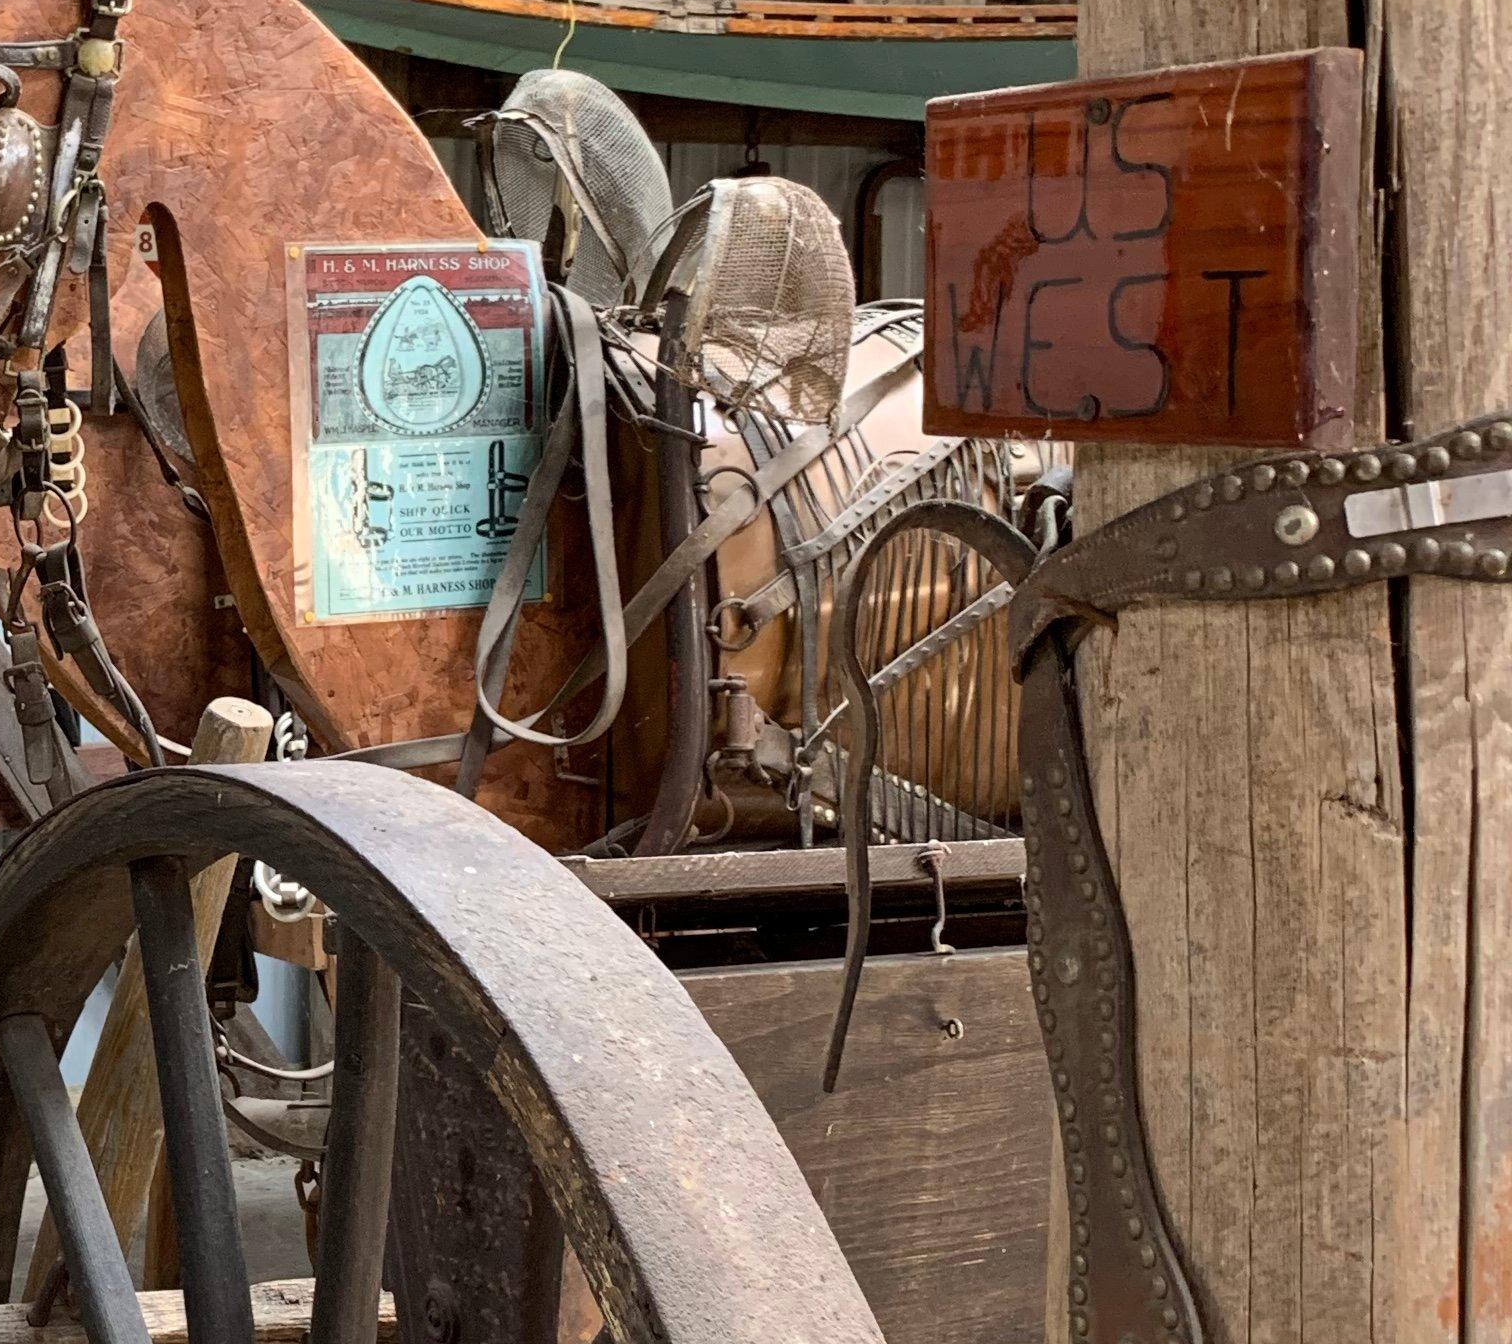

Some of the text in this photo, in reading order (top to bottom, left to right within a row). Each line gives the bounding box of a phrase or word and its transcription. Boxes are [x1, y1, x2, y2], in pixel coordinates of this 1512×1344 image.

[322, 259, 339, 274] H.
[344, 258, 356, 273] &
[385, 256, 461, 273] HARNESS
[467, 255, 511, 272] SHOP
[945, 269, 1269, 421] WEST
[472, 417, 520, 429] MANAGER
[399, 506, 427, 518] SHIP
[399, 523, 472, 538] OUR MOTTO
[416, 580, 466, 595] HARNESS
